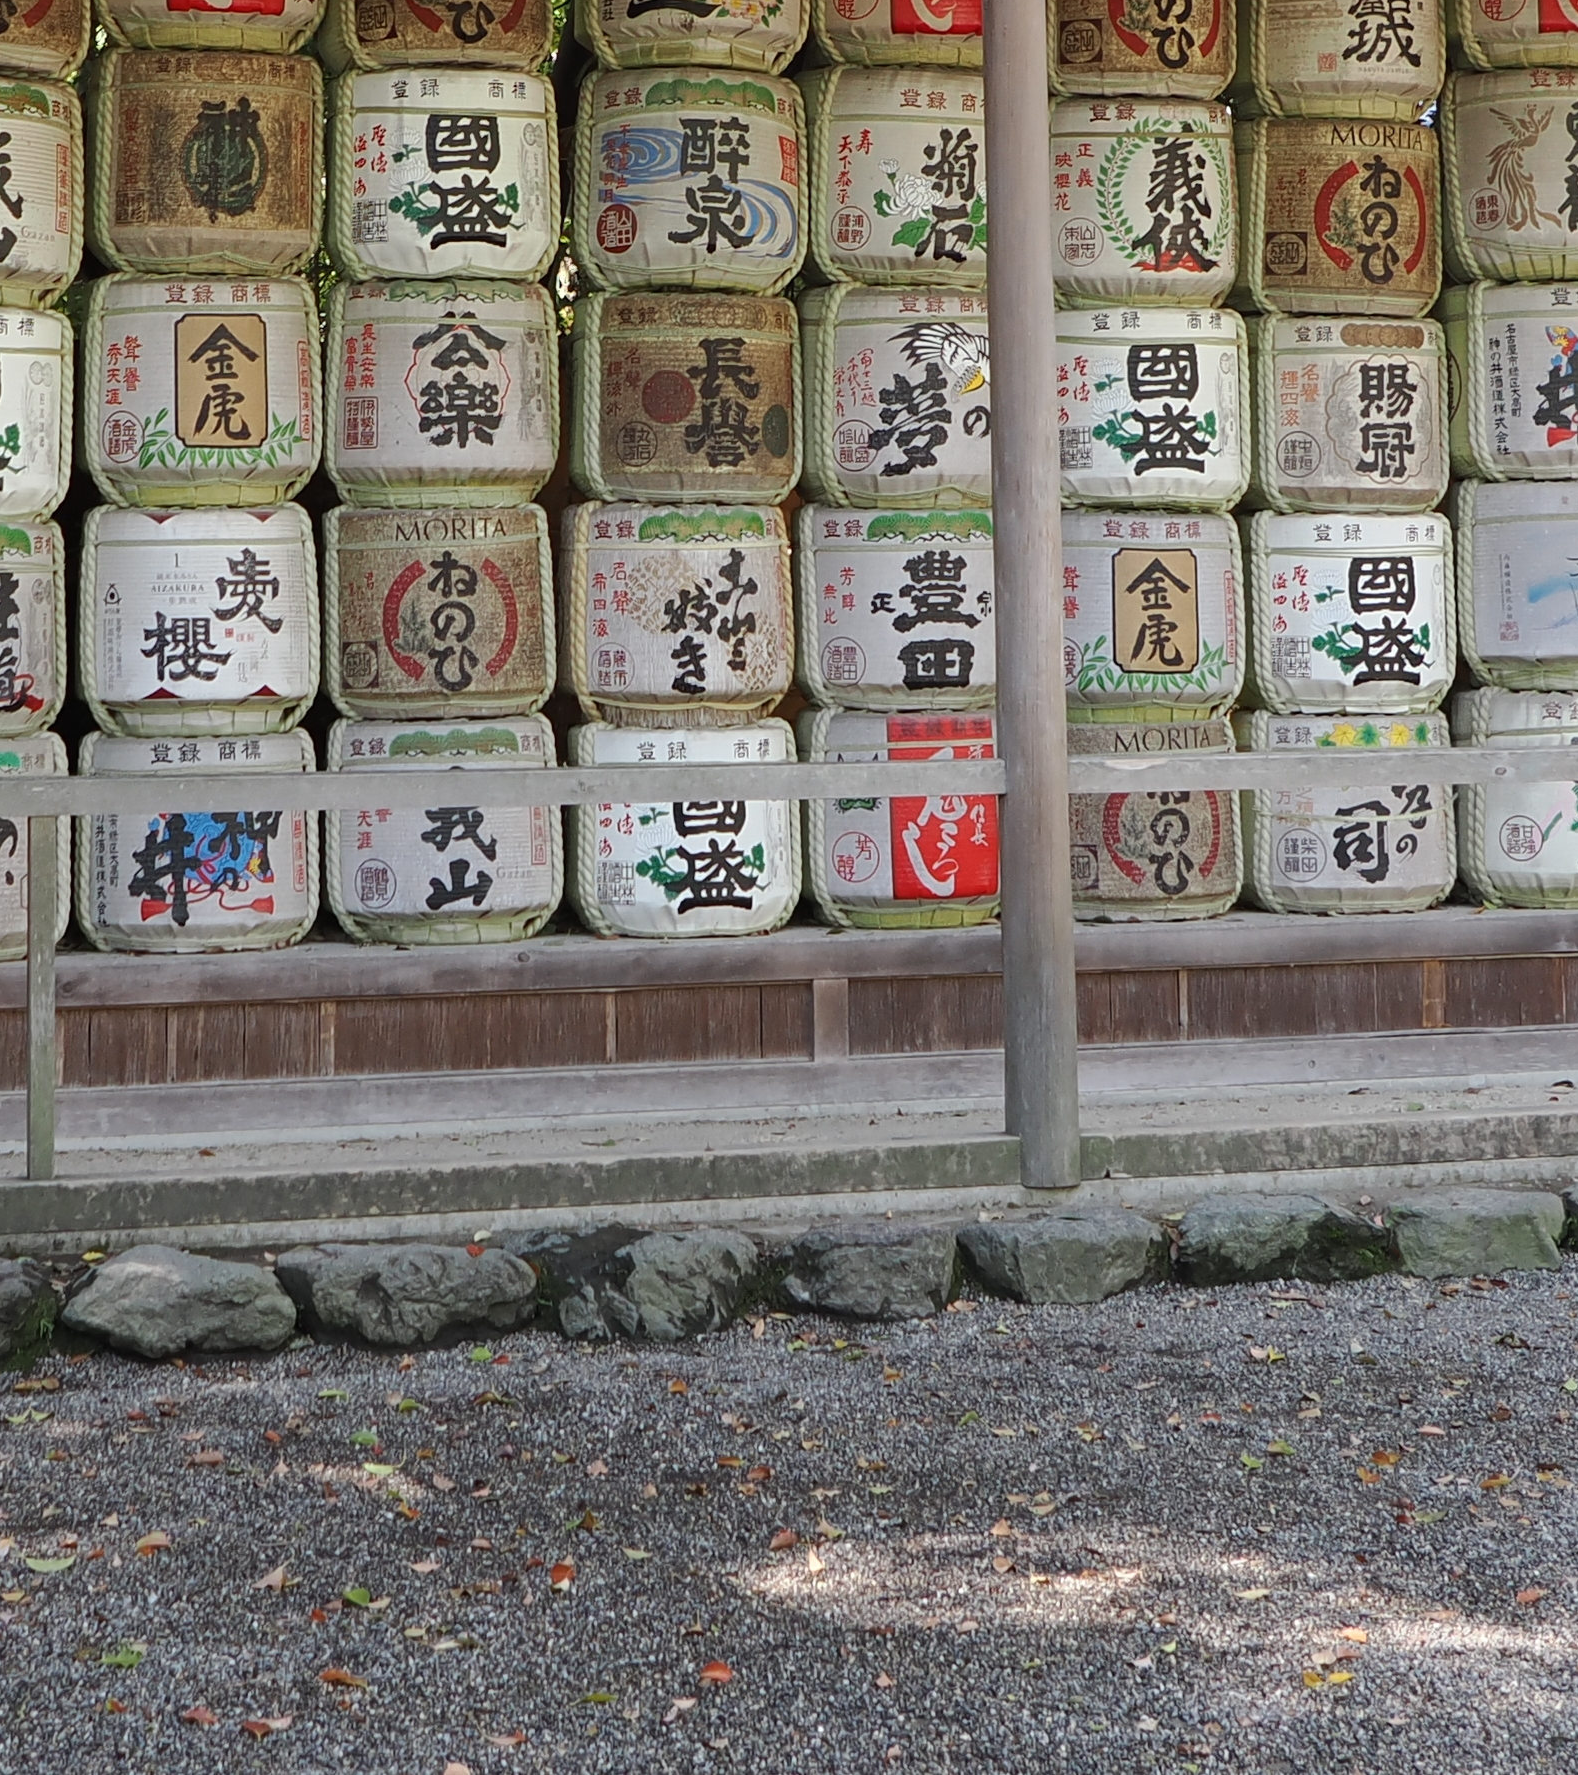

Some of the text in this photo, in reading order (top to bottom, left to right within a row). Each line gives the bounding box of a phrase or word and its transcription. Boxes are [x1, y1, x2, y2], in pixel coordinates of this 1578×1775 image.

[391, 80, 526, 99] 登録 商標
[1530, 70, 1576, 87] 登録
[605, 87, 643, 109] 登録
[899, 90, 947, 110] 登録
[1089, 104, 1136, 121] 登録
[1330, 124, 1422, 150] MORITA
[420, 114, 512, 249] 國盛
[915, 127, 977, 262] 菊石
[1132, 123, 1211, 270] 義侠
[1357, 155, 1402, 285] ねのひ
[165, 284, 272, 303] 登録 商標
[899, 297, 944, 314] 登録
[1093, 312, 1222, 331] 登録 商標
[1295, 327, 1334, 343] 登録
[187, 323, 260, 441] 金虎
[1489, 338, 1511, 455] 神の井酒造株式会社
[1125, 344, 1210, 476] 國盛
[395, 517, 507, 541] MORITA
[594, 521, 635, 539] 登録
[823, 521, 864, 538] 登録
[1103, 520, 1201, 539] 登録 商標
[1313, 525, 1435, 543] 登録 商標
[151, 584, 205, 593] AIZAKURA
[427, 550, 479, 691] ねのひ
[1124, 558, 1191, 665] 金虎
[1345, 557, 1424, 686] 國盛
[1113, 729, 1212, 753] MORITA
[1274, 726, 1312, 745] 登録
[151, 742, 261, 763] 登録 商標
[349, 738, 387, 756] 登録
[637, 739, 770, 761] 登録 商標
[1334, 800, 1390, 884] 司
[834, 835, 873, 882] 芳醇
